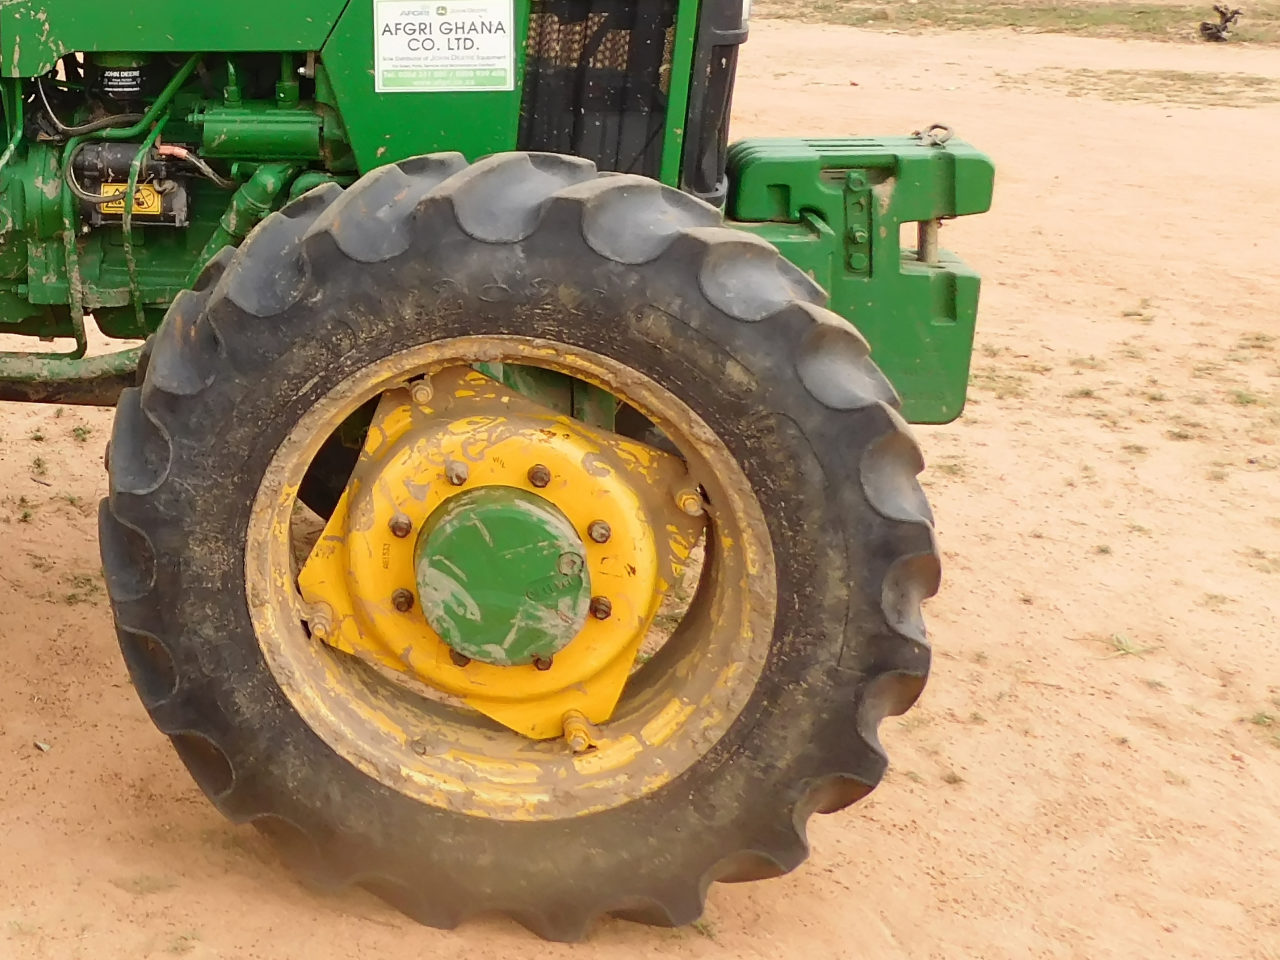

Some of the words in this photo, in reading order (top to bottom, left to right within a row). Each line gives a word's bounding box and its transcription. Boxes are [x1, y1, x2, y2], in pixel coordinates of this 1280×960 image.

[381, 22, 433, 36] AFGRI
[439, 21, 507, 35] GHANA
[407, 38, 441, 52] CO.
[447, 38, 480, 52] LTD.
